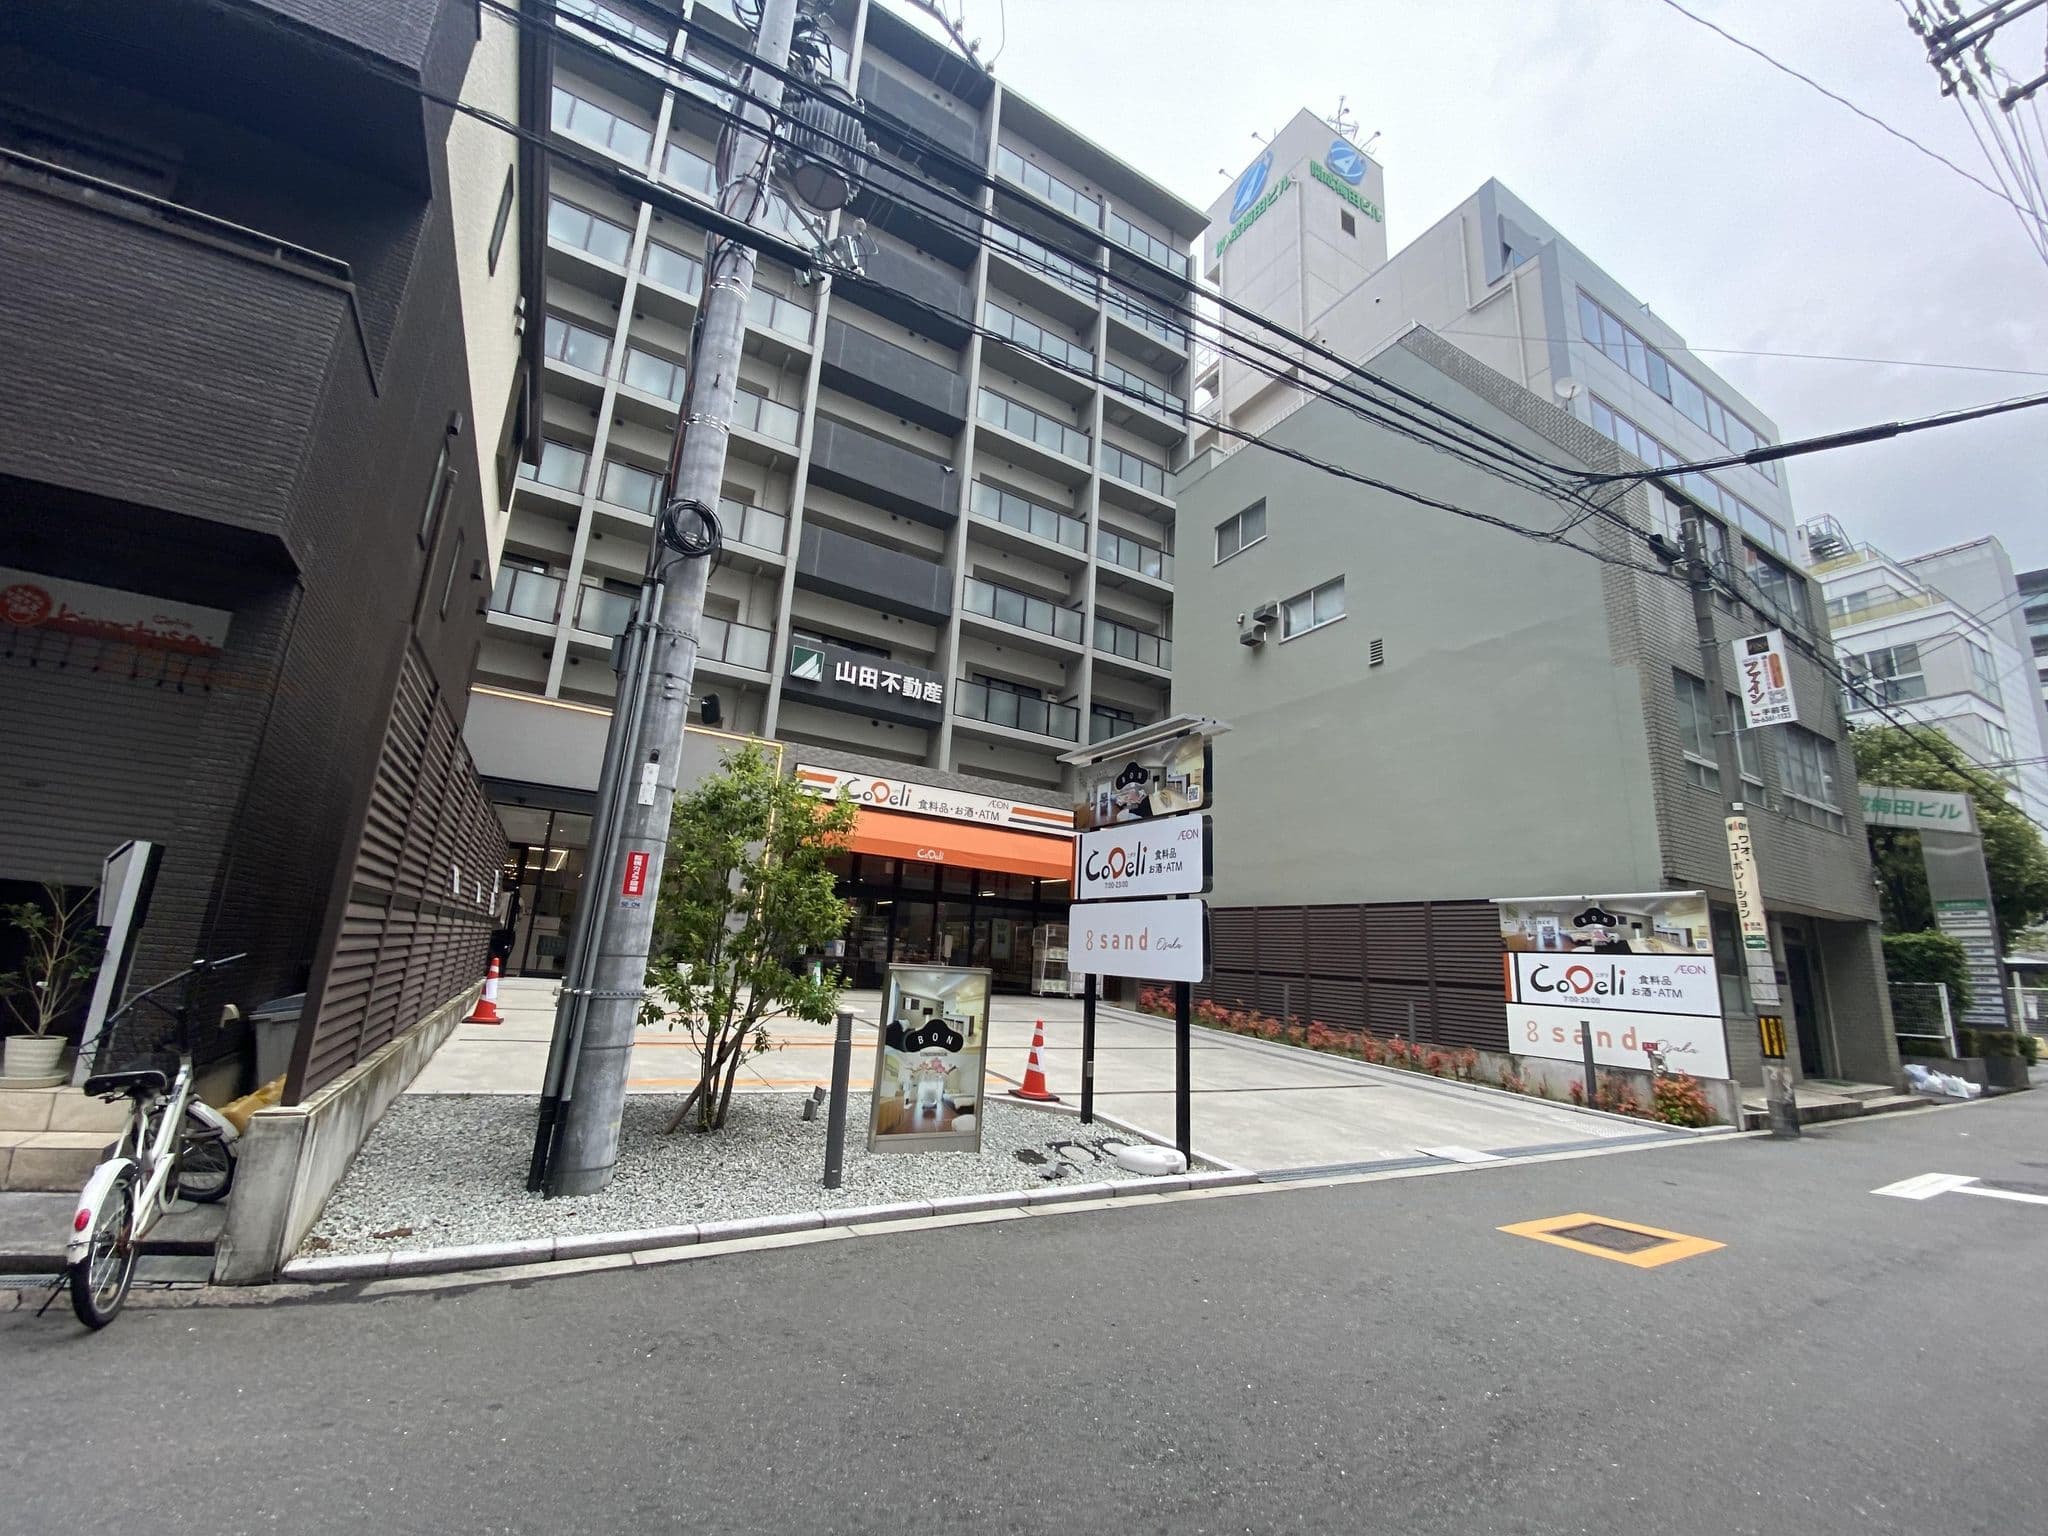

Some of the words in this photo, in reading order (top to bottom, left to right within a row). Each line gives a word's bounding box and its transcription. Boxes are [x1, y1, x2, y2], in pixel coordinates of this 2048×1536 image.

[835, 661, 944, 704] 山田不動産
[1744, 661, 1765, 705] ファイン
[1085, 841, 1148, 881] CoDeli
[1154, 847, 1177, 860] 食料品
[1731, 843, 1750, 918] コーポレーション
[1100, 927, 1148, 951] sand
[1530, 963, 1626, 996] CoDeli
[1638, 975, 1673, 986] 食料品
[918, 1032, 953, 1046] BON
[1552, 1026, 1638, 1051] sand
